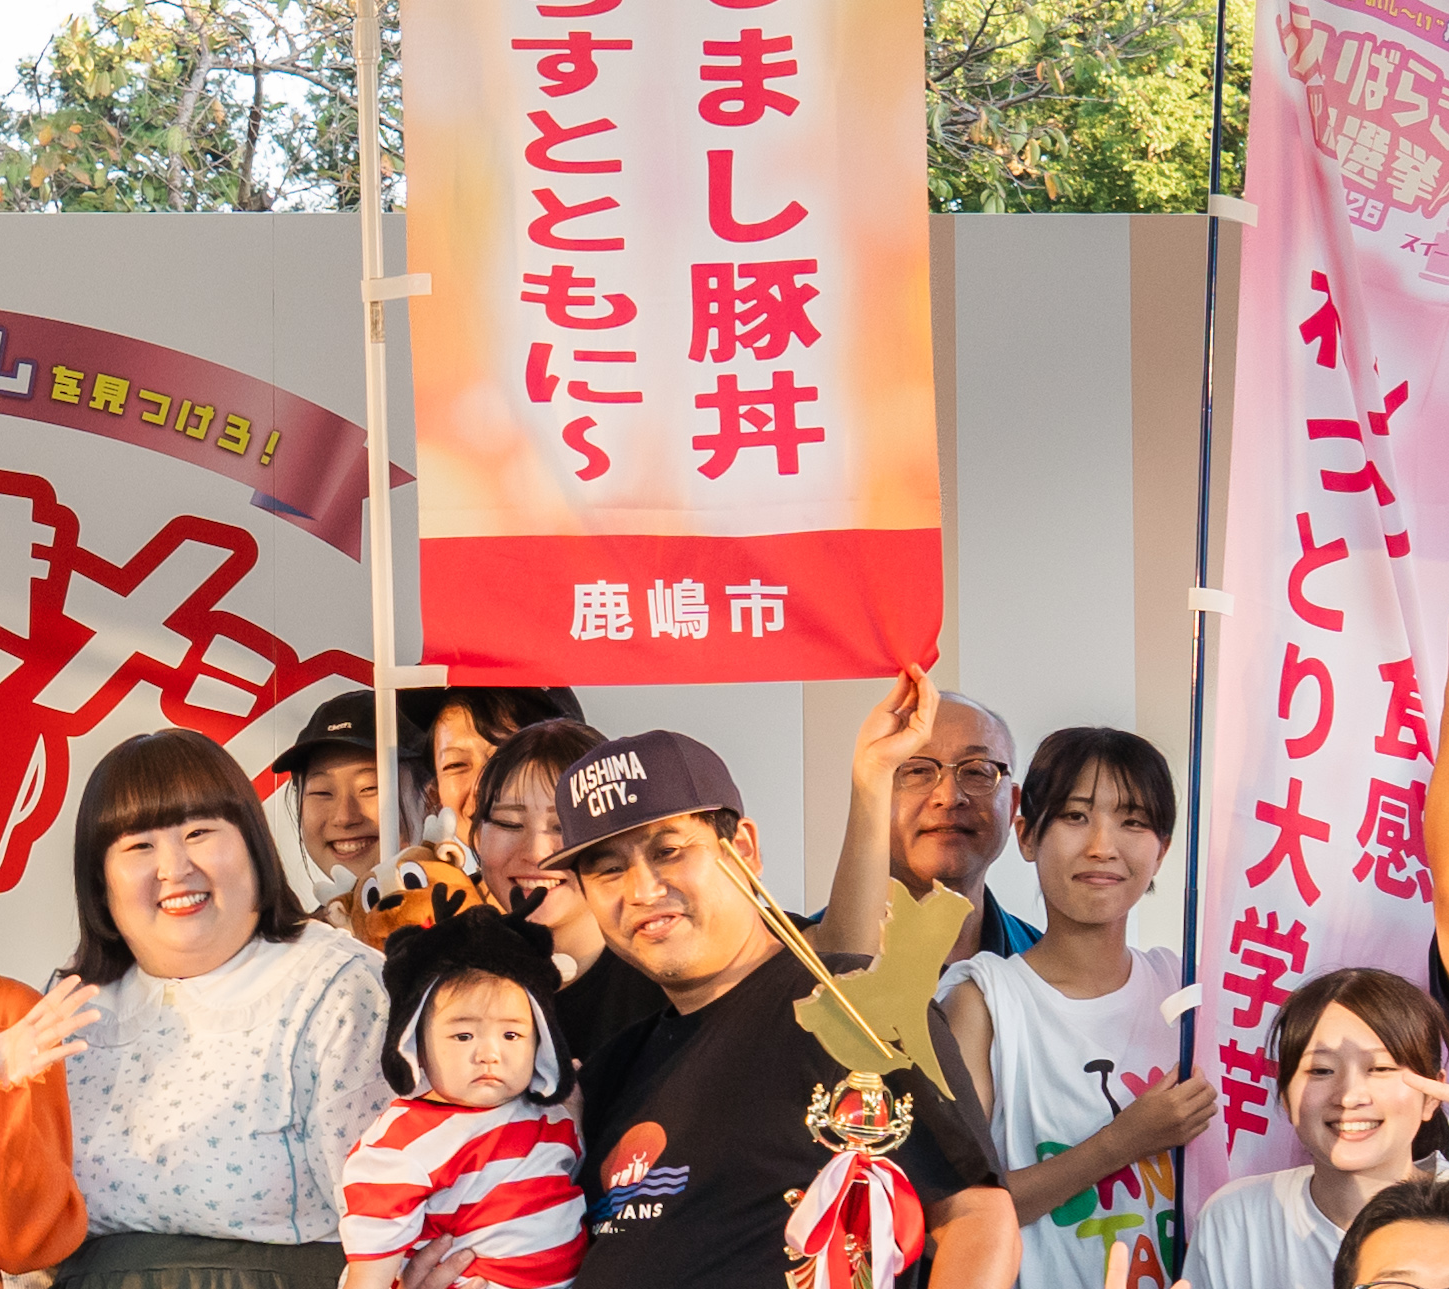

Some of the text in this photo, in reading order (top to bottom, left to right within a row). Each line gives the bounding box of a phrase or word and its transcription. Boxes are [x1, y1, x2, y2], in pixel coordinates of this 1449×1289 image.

[569, 578, 789, 641] 鹿嶋市
[569, 750, 648, 808] KASHIMA
